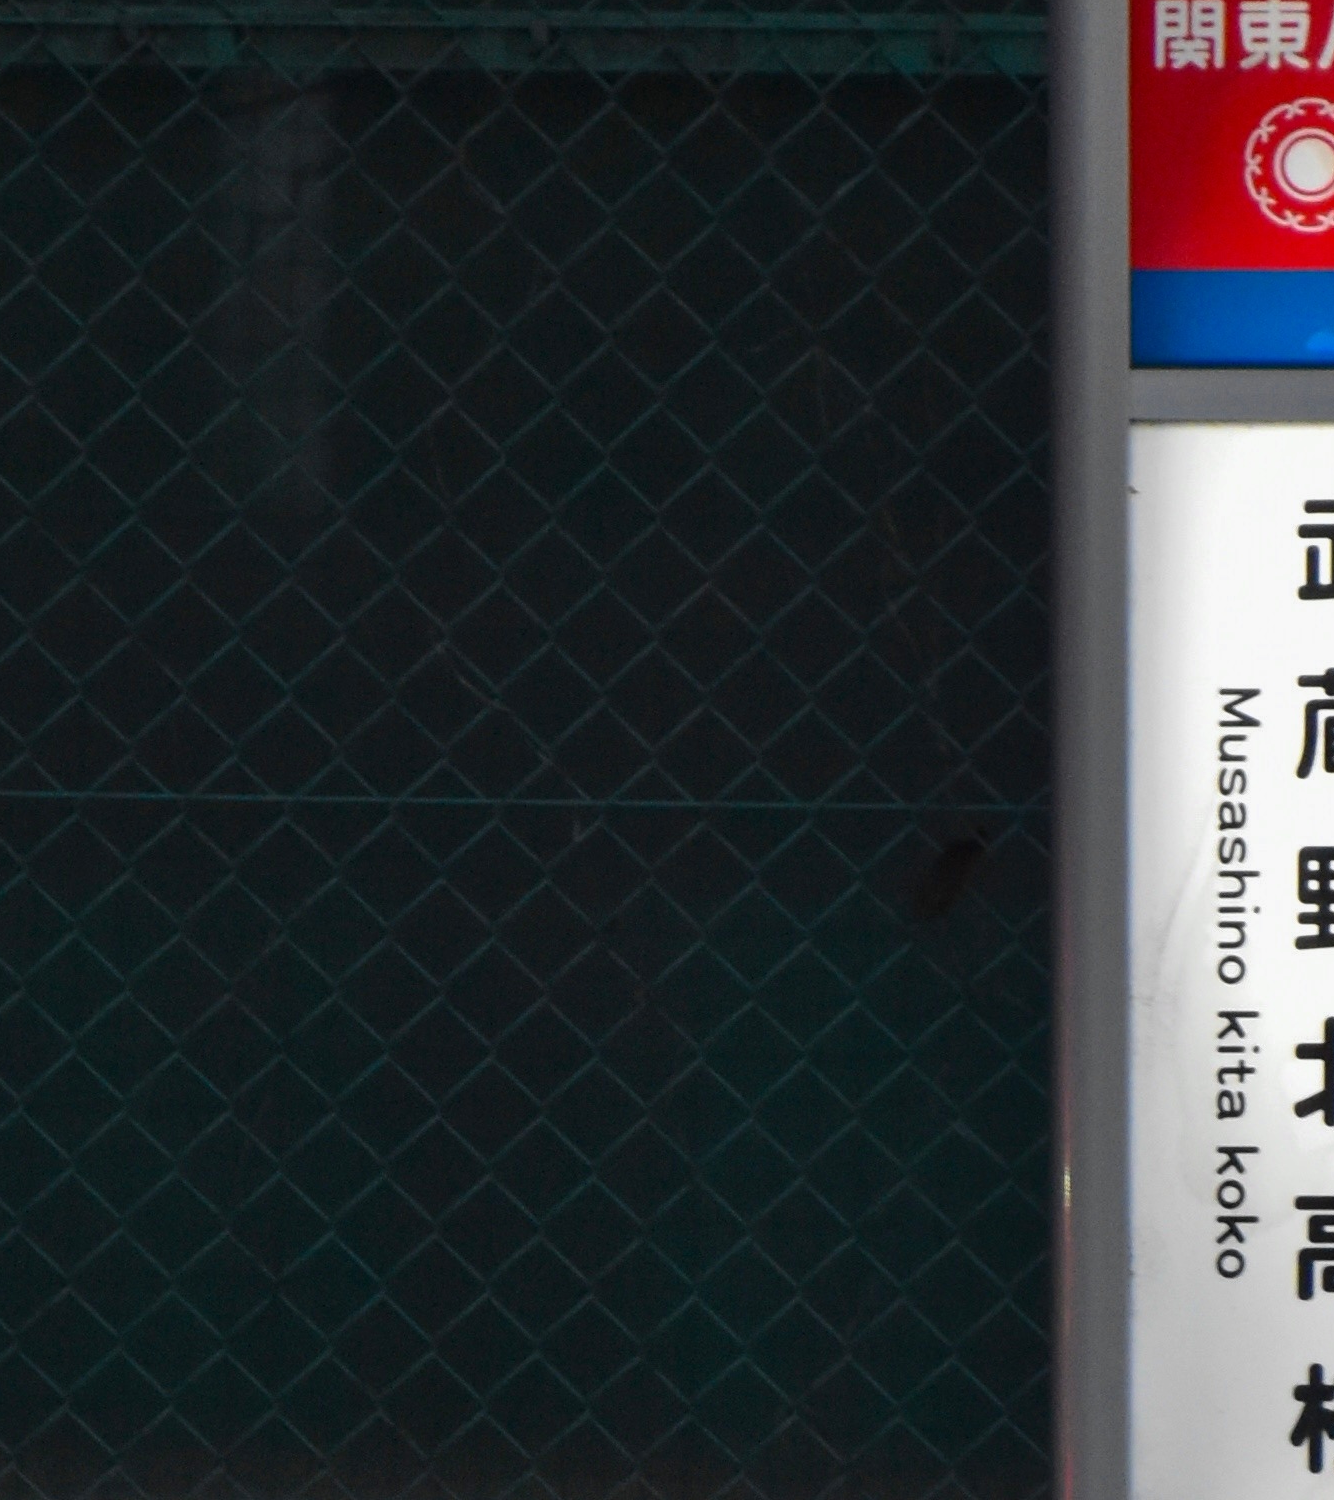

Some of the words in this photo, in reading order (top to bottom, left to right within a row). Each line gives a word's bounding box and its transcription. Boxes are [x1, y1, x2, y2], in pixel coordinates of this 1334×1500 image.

[1216, 687, 1263, 987] Musashino
[1216, 1010, 1262, 1122] kita
[1215, 1145, 1262, 1282] koko
